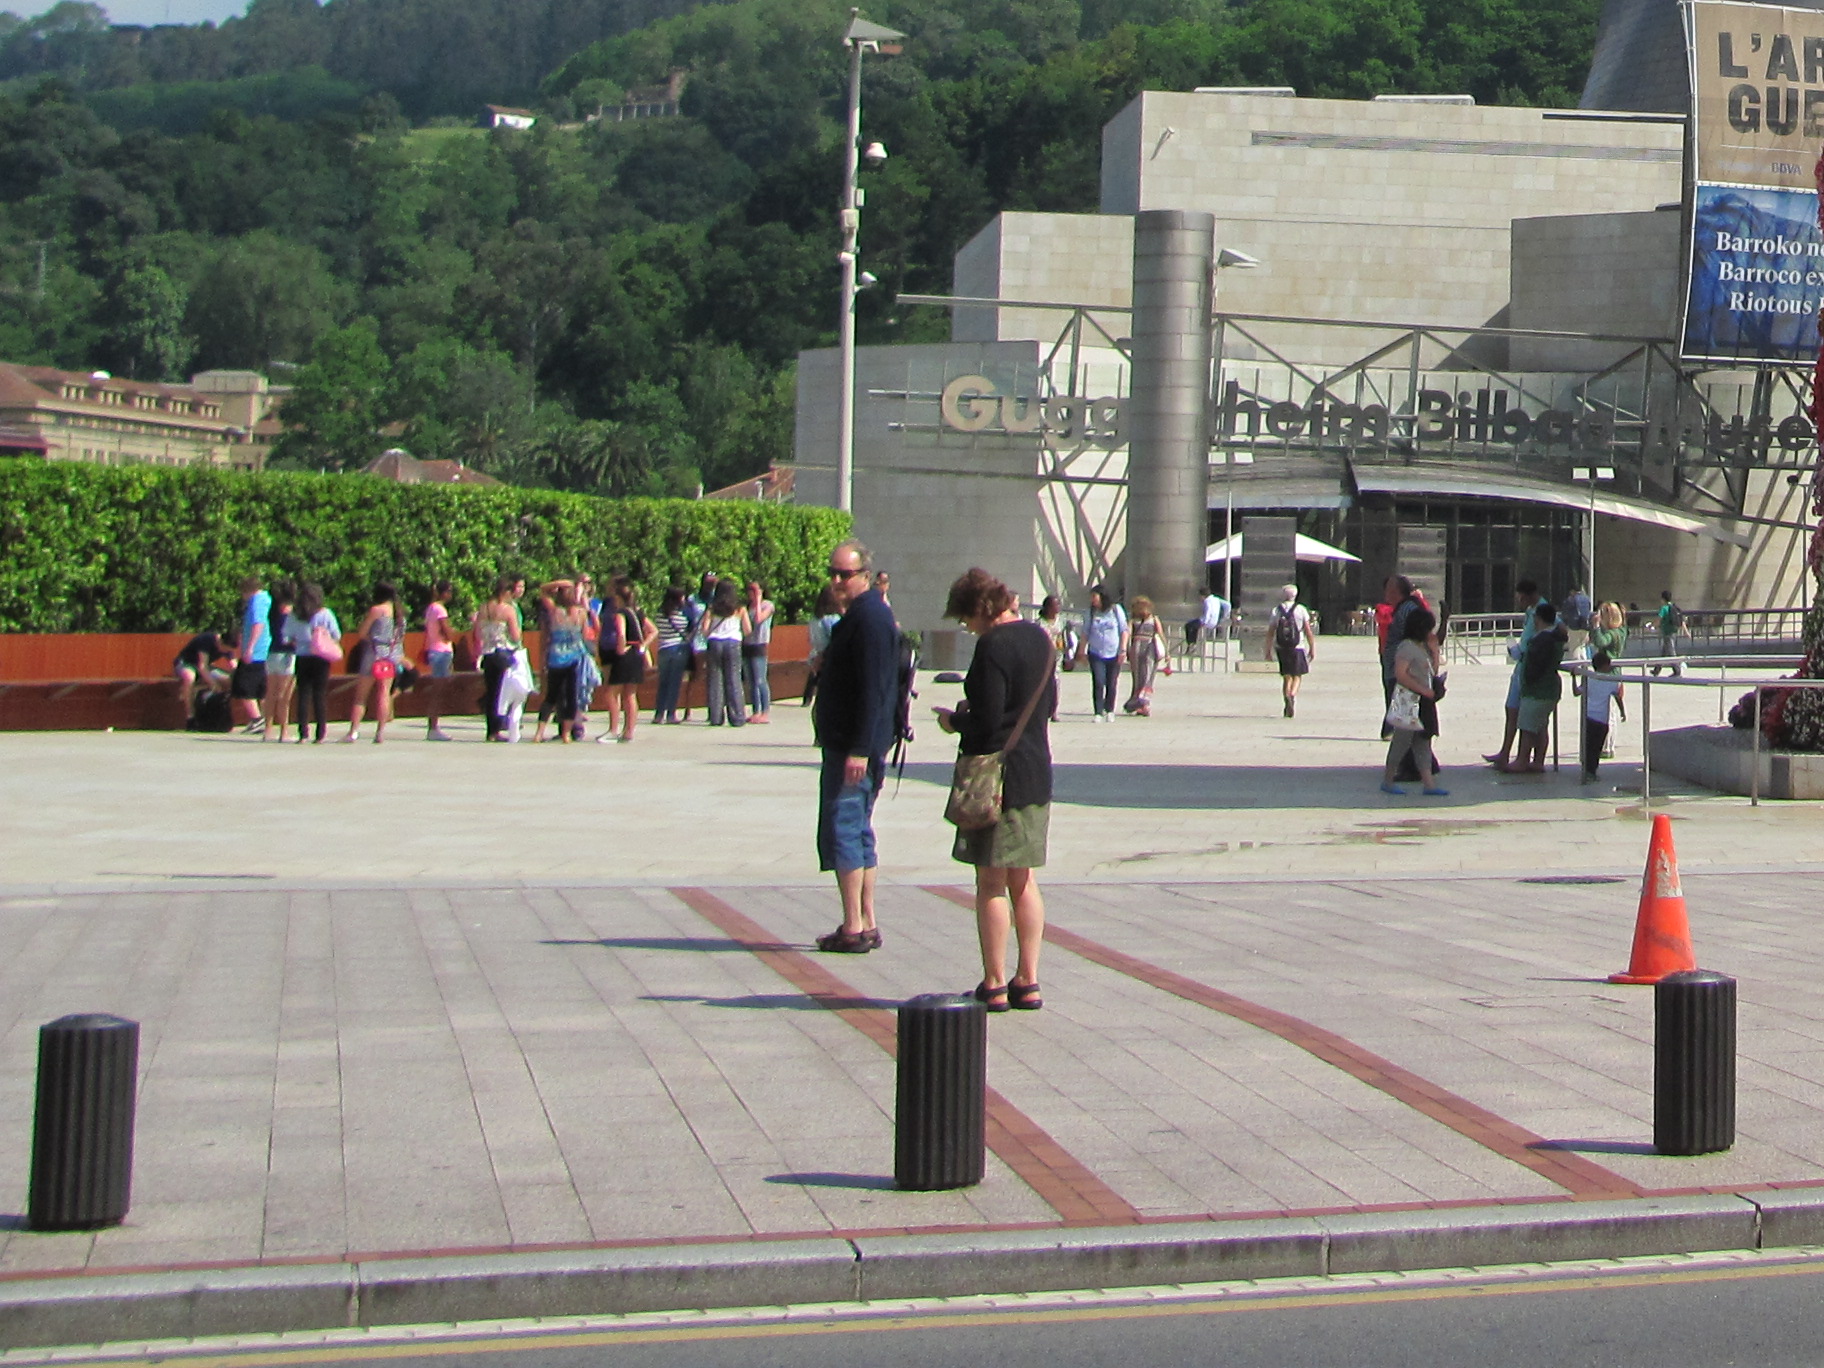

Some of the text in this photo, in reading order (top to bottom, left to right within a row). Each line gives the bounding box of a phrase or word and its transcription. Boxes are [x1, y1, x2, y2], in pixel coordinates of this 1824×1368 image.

[1771, 162, 1802, 176] BBVA
[1715, 231, 1802, 255] Barroko
[1718, 261, 1801, 286] Barroco
[1729, 291, 1813, 315] Riotous
[941, 374, 1389, 450] Guggheim
[1418, 389, 1615, 446] Bilbao
